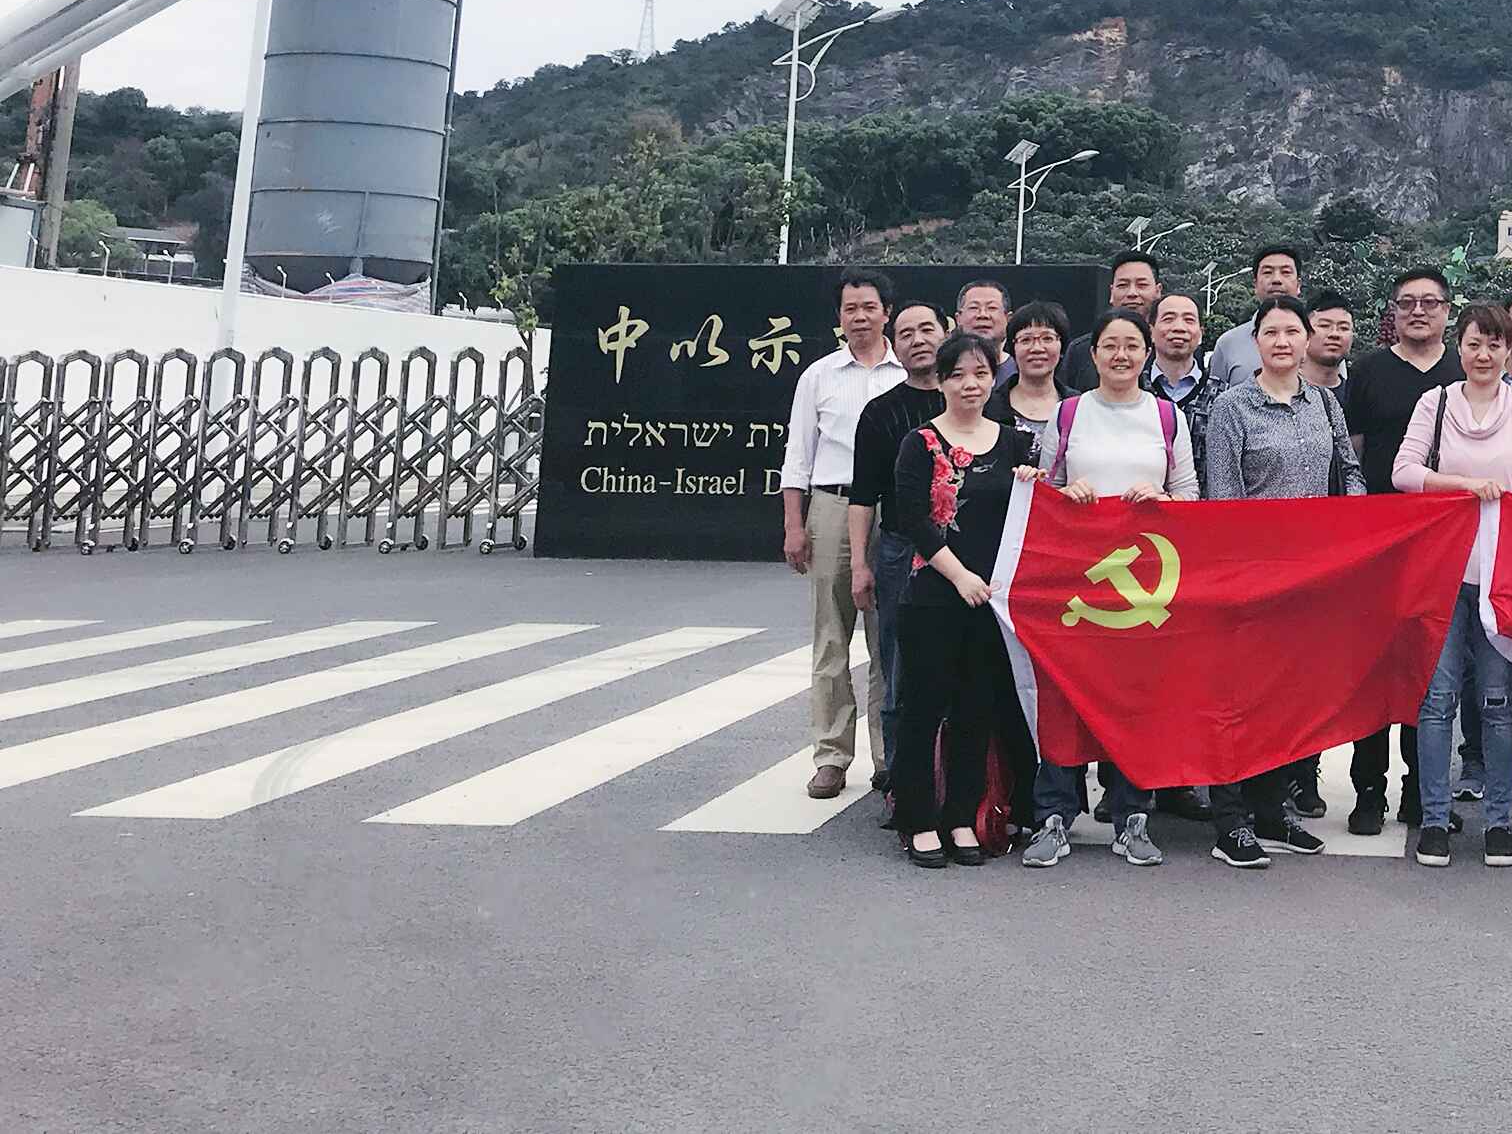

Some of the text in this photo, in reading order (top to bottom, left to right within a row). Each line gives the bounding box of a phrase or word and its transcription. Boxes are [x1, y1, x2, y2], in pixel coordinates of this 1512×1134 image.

[598, 305, 848, 384] 中以示
[583, 413, 734, 448] ישראלית
[580, 466, 745, 496] China-Israel
